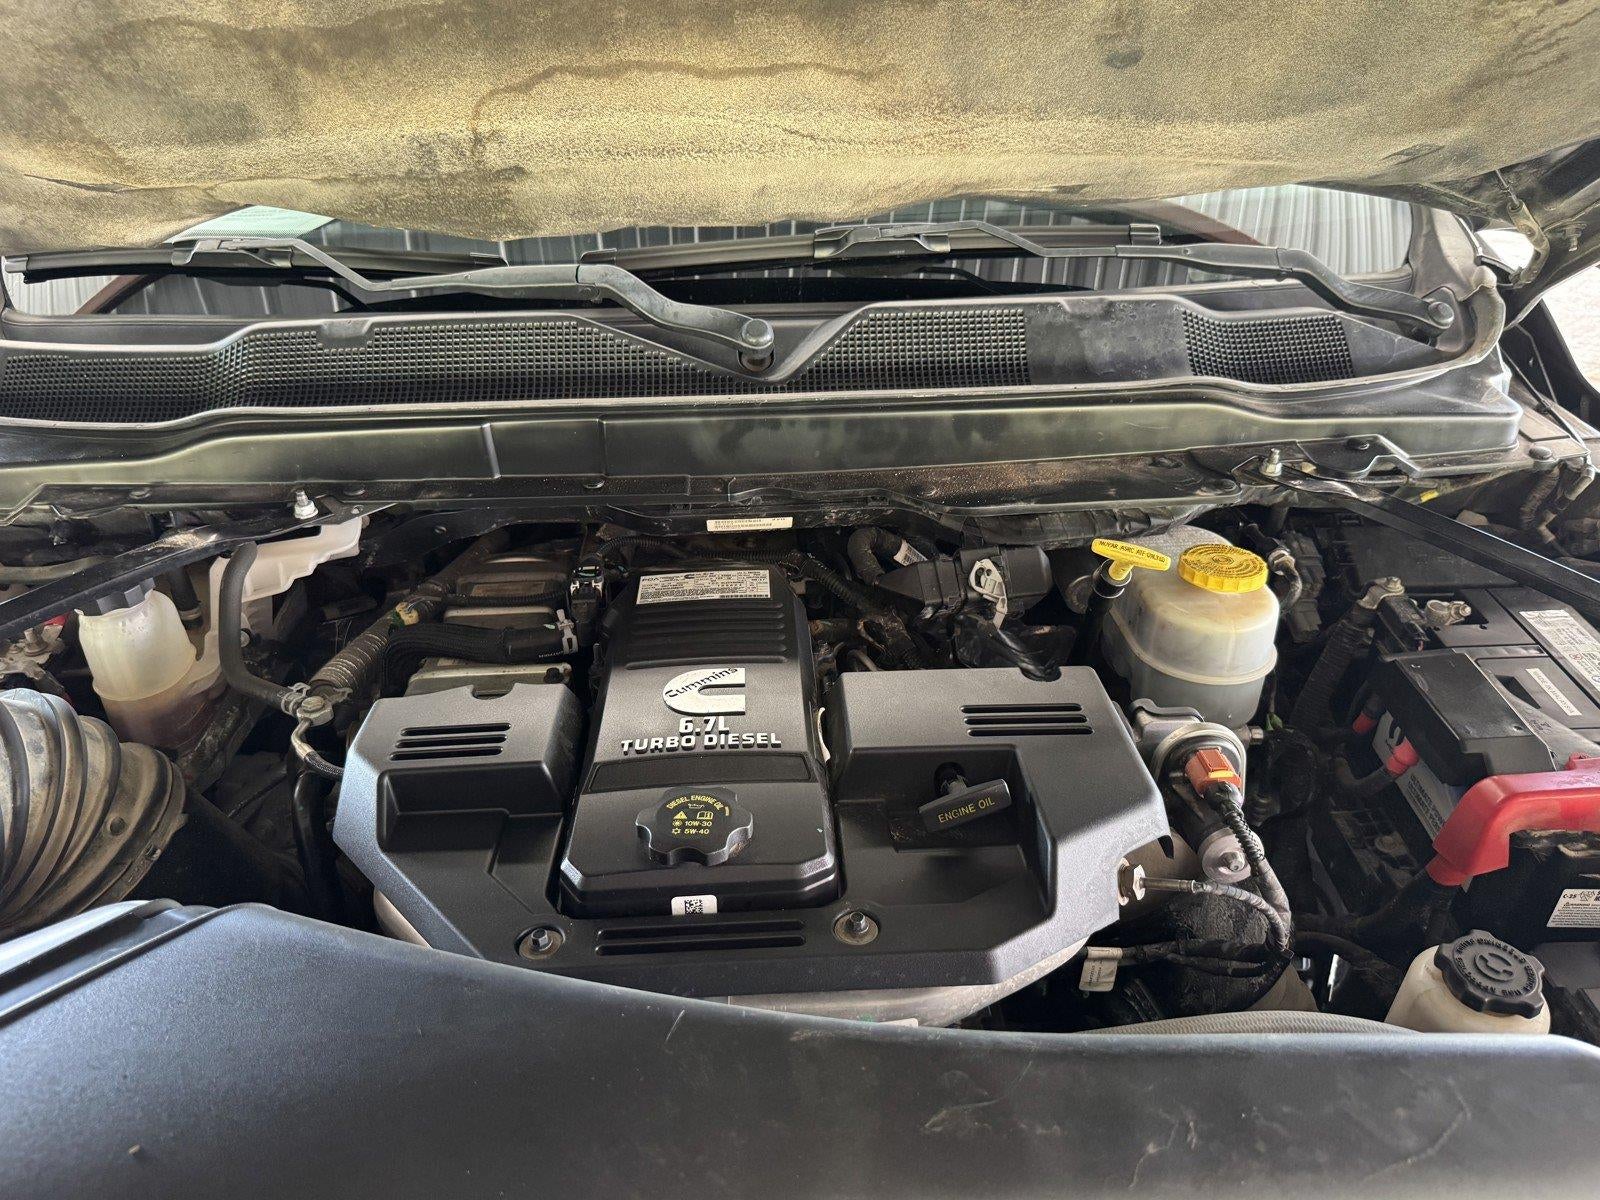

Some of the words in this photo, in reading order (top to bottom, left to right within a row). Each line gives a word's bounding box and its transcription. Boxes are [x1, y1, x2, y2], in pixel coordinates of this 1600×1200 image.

[664, 667, 738, 698] Cummins
[679, 716, 730, 736] 6.7L
[620, 735, 697, 755] TURBO
[703, 732, 782, 750] DIESEL
[666, 796, 690, 810] DIESEL
[690, 794, 717, 805] ENGINE
[937, 803, 977, 823] ENGINE
[978, 797, 996, 810] OIL
